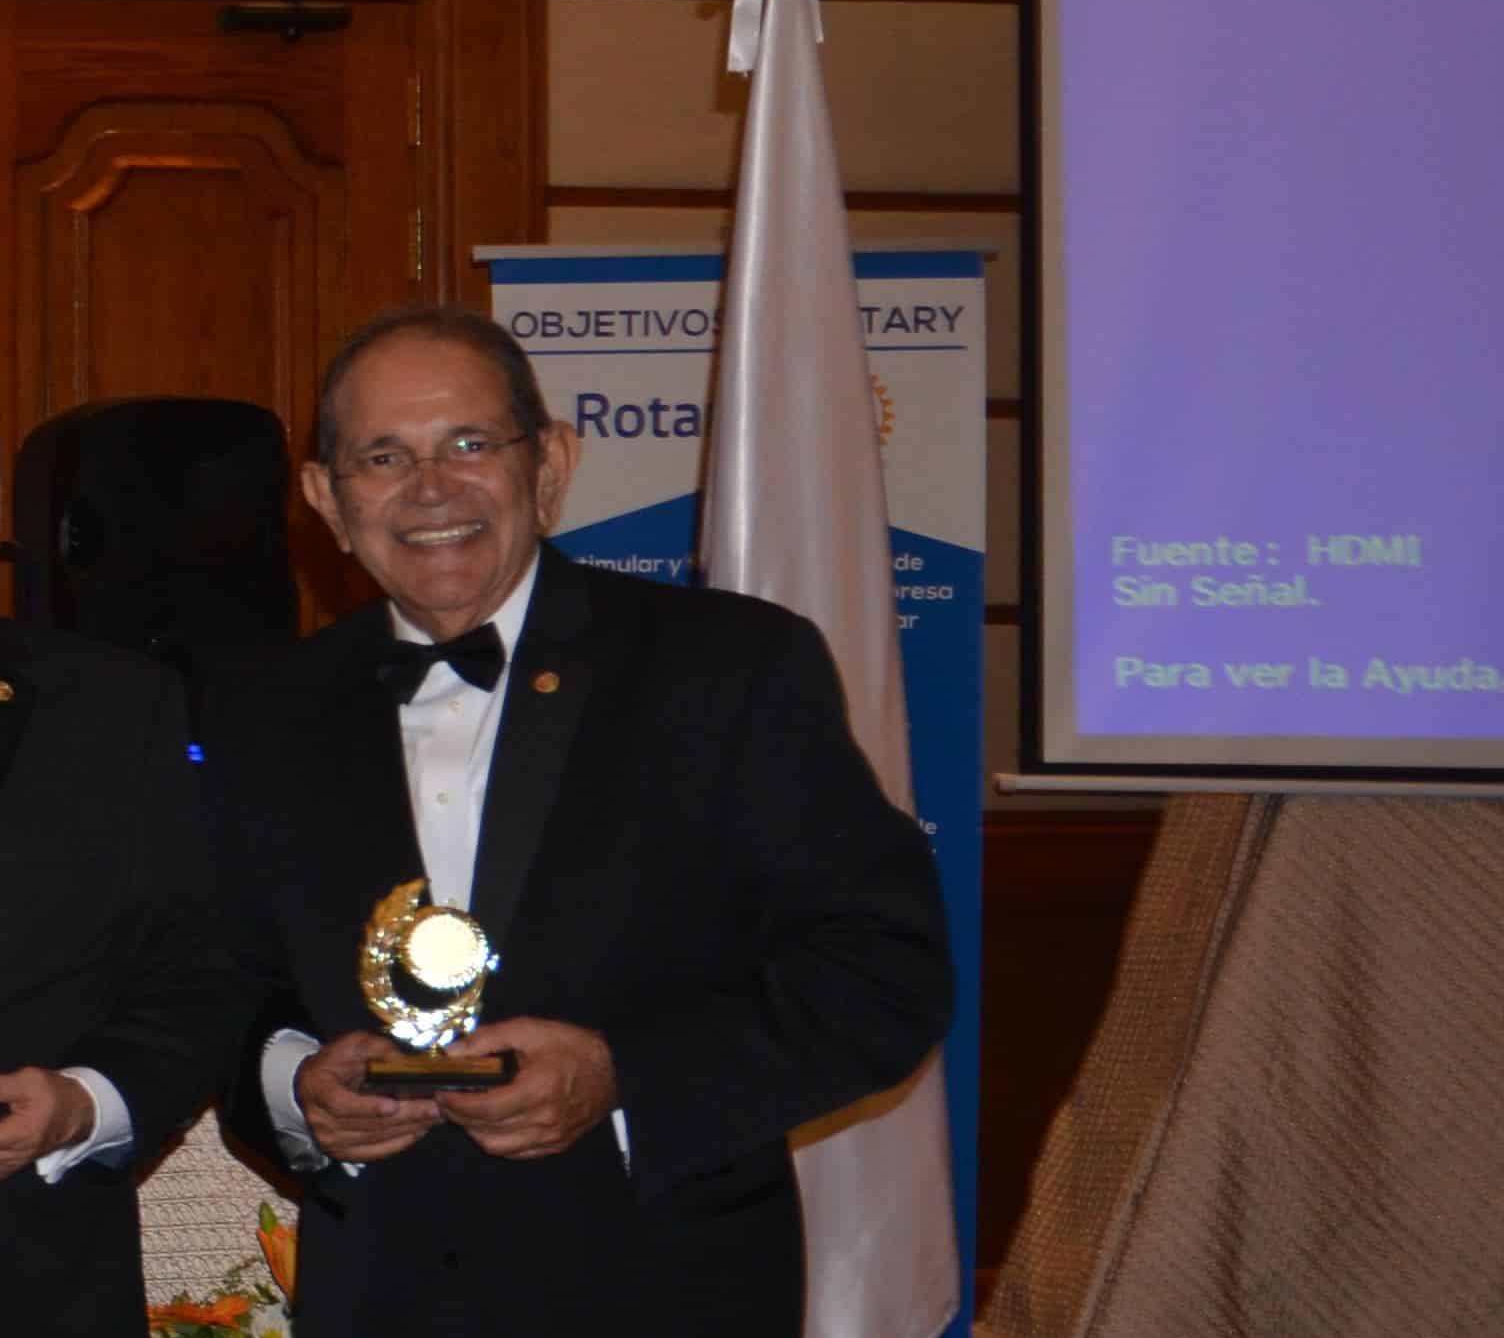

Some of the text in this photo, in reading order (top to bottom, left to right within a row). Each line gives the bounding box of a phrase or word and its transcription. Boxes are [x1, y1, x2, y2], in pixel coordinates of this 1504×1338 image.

[860, 305, 966, 334] TARY
[576, 392, 702, 438] Rota
[1111, 534, 1422, 567] Fuente: HDMI
[1112, 577, 1177, 607] Sin
[1114, 657, 1211, 689] Para
[1224, 662, 1292, 689] ver
[1309, 657, 1348, 689] la
